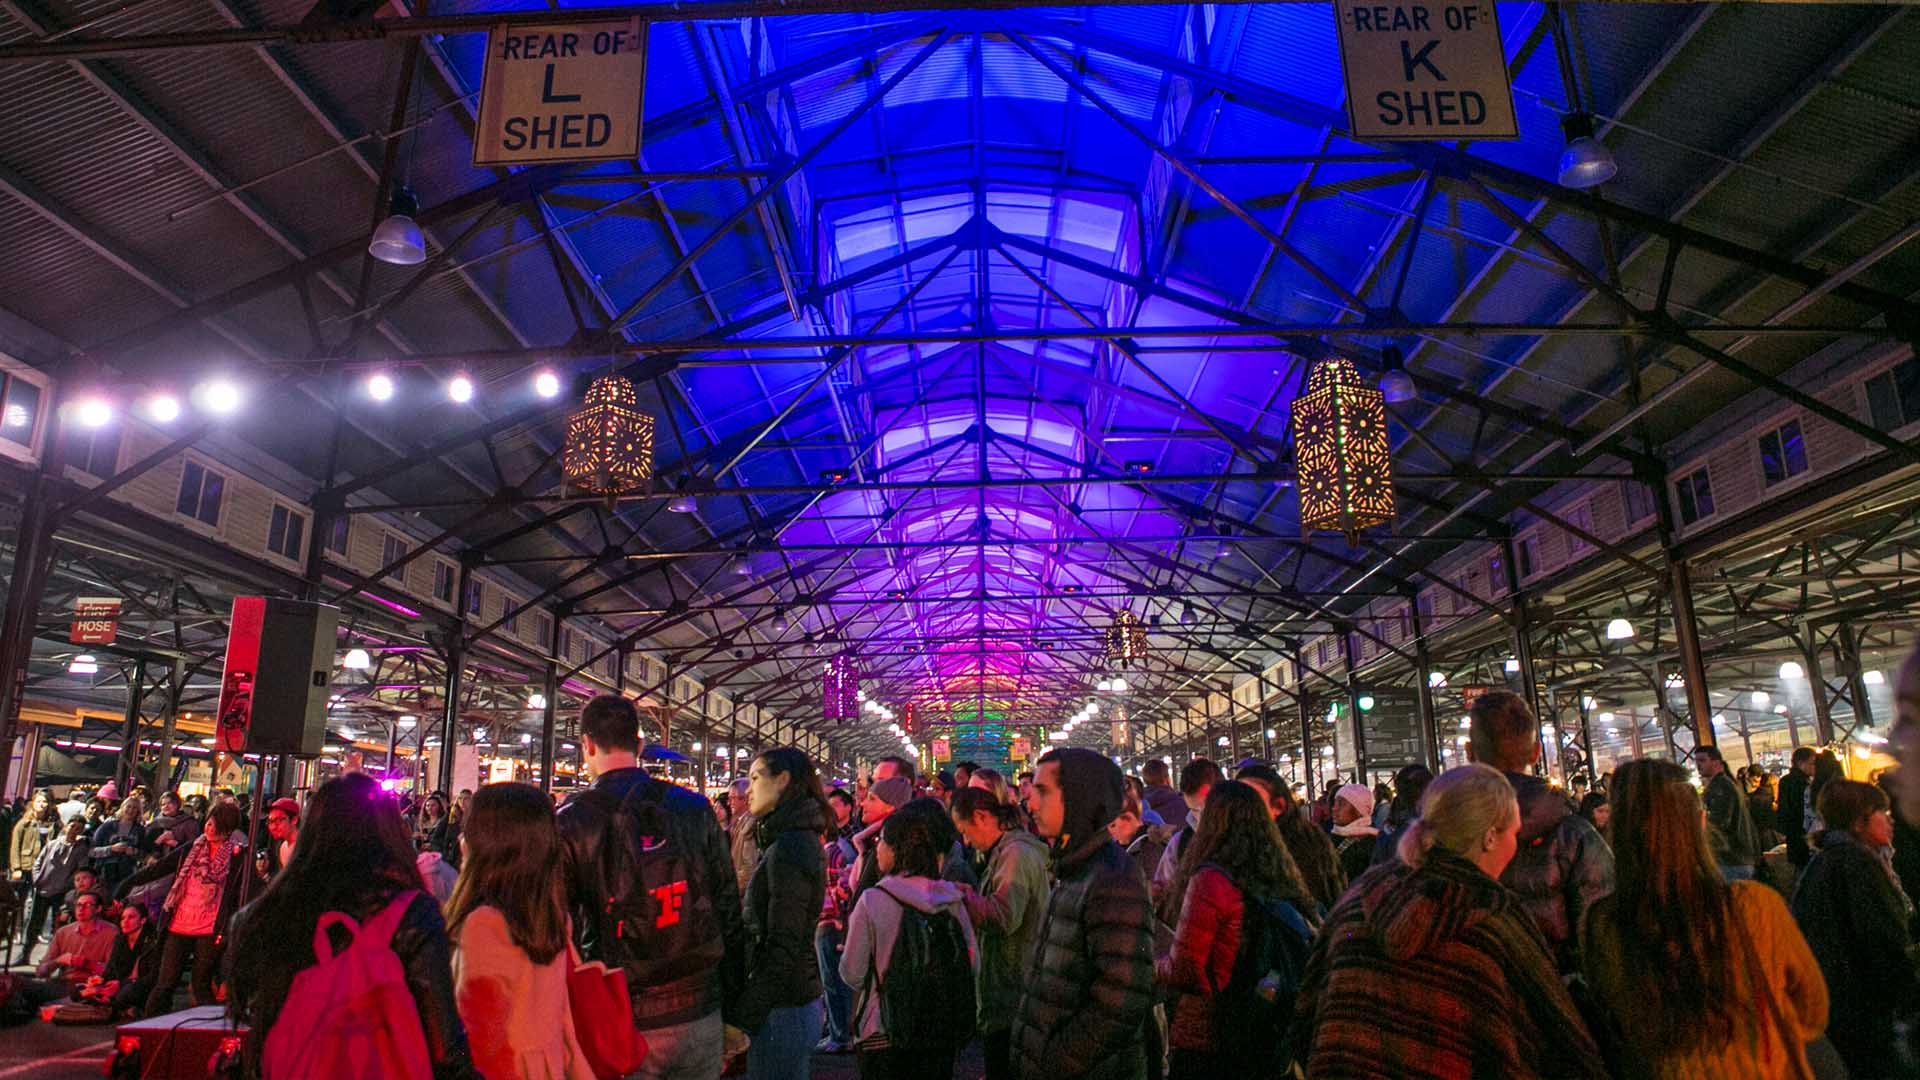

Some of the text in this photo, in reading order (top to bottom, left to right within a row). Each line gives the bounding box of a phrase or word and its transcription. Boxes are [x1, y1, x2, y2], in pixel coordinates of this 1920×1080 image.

[1353, 6, 1478, 32] REAR OF
[504, 30, 629, 60] REAR OF
[1401, 40, 1448, 81] K
[542, 63, 581, 103] L
[1377, 91, 1486, 126] SHED
[504, 113, 611, 151] SHED
[78, 621, 111, 632] HOSE
